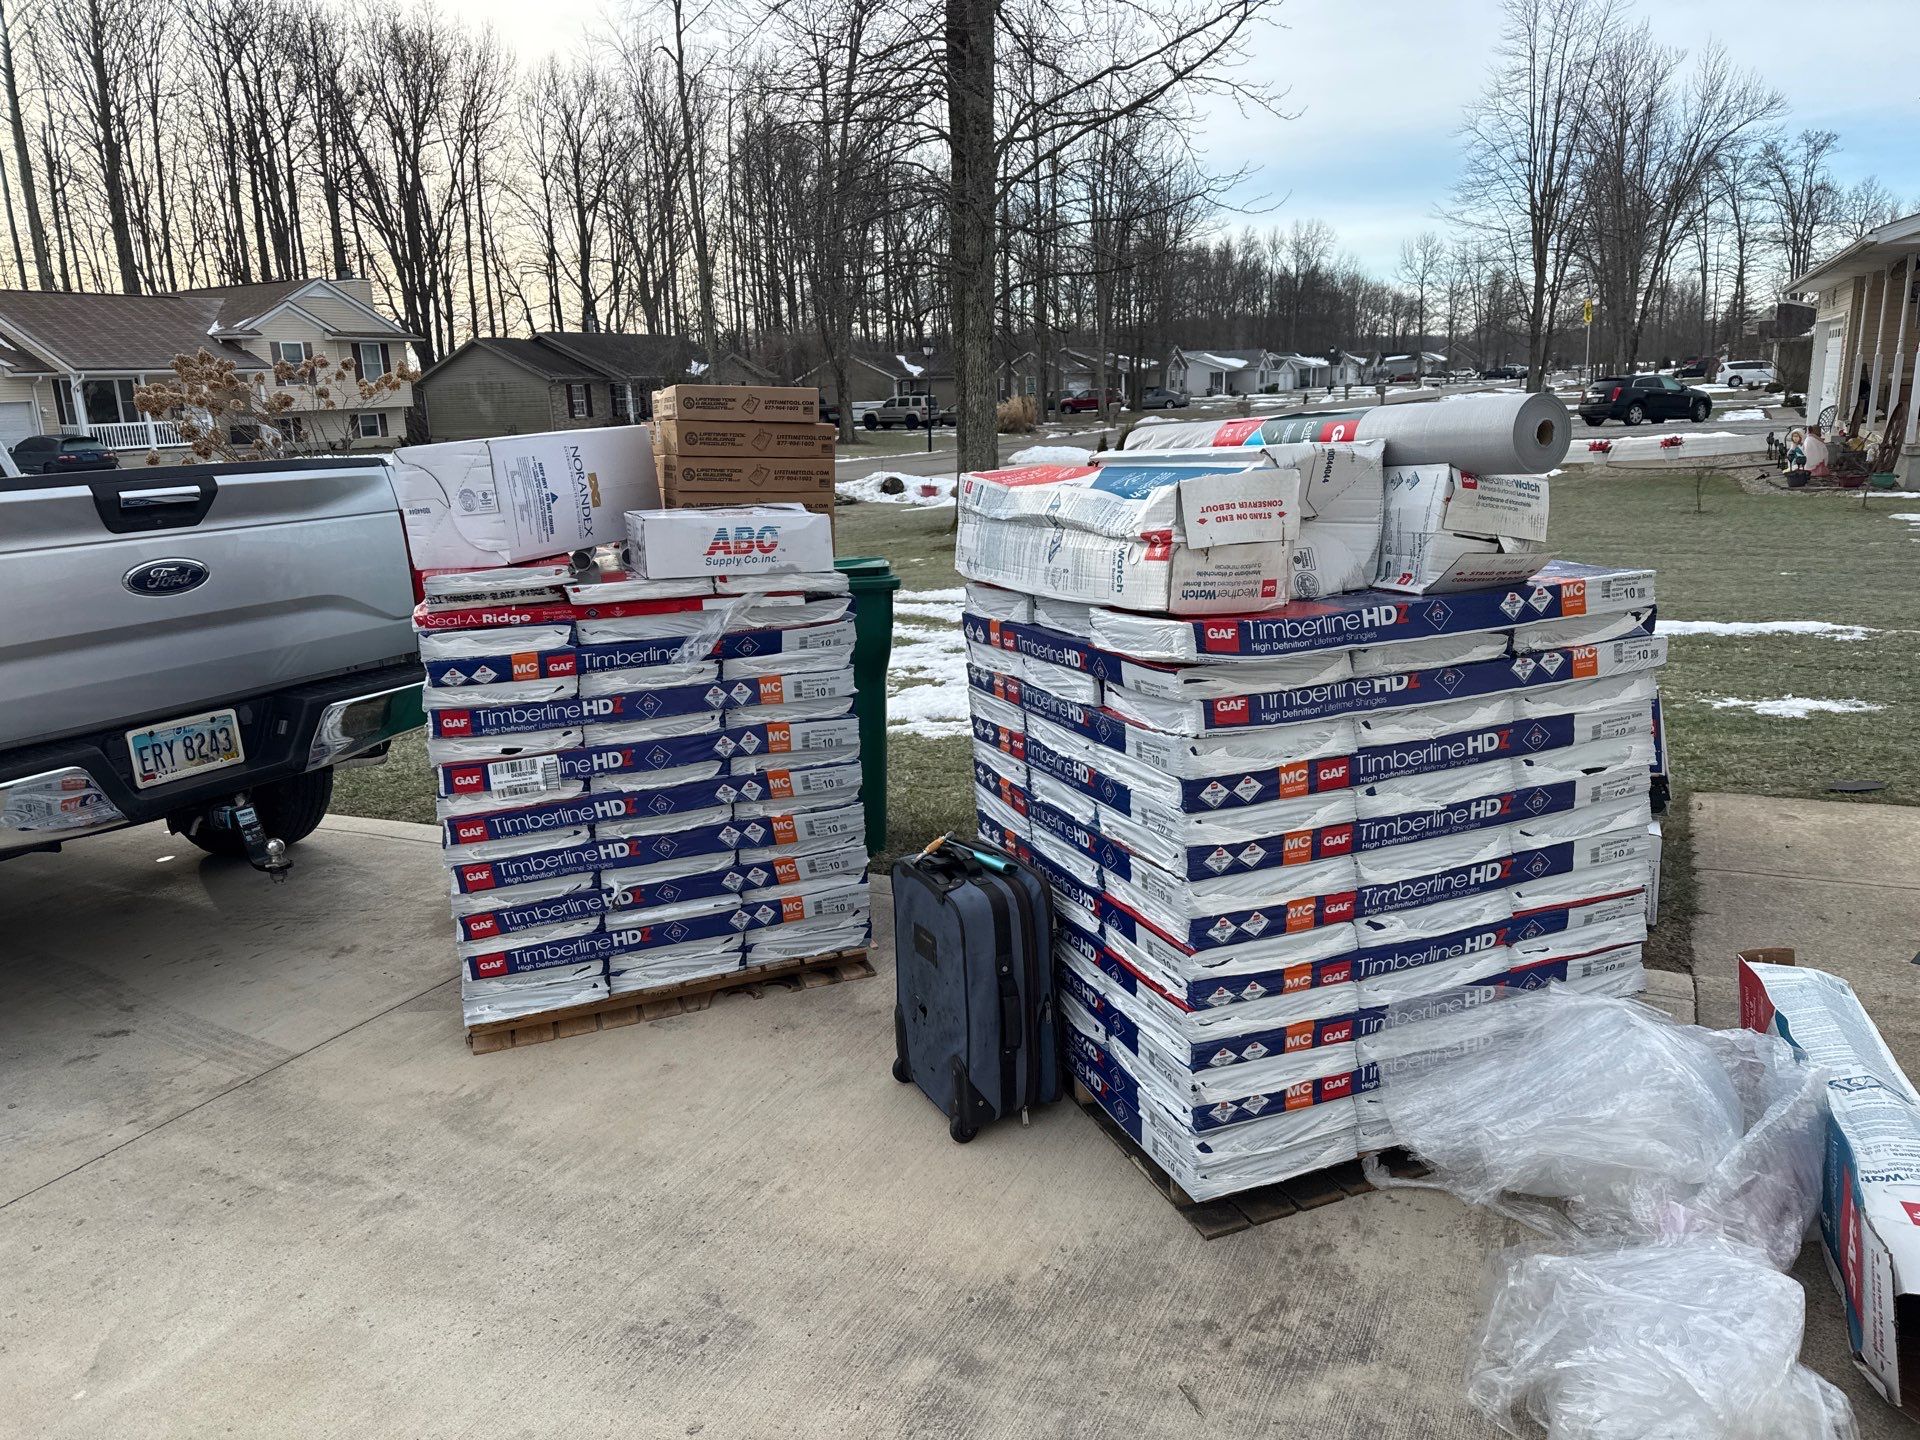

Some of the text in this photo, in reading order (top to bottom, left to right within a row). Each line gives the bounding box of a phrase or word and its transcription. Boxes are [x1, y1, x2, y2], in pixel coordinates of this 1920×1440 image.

[537, 462, 545, 477] KEEP
[570, 446, 593, 538] NORANDEX
[1200, 500, 1283, 514] CONSERVER DEBOUT
[1215, 511, 1272, 523] STAND ON END
[703, 525, 781, 556] ABC
[705, 556, 741, 567] Supply
[147, 566, 192, 589] Ford
[1181, 588, 1259, 601] WeatherWatch
[1561, 583, 1585, 598] MC
[1623, 587, 1636, 599] 10
[427, 612, 532, 627] Seal-A-Ridge
[989, 632, 1000, 641] MC
[1003, 637, 1015, 647] GAF
[1207, 627, 1236, 641] GAF
[820, 639, 831, 647] 10
[1251, 631, 1378, 653] High Definition Lifetime Shingles
[1573, 647, 1597, 660] MC
[1636, 650, 1649, 661] 10
[513, 662, 538, 675] MC
[549, 662, 574, 672] GAF
[760, 682, 782, 693] MC
[815, 688, 826, 697] 10
[1216, 699, 1246, 713] GAF
[1261, 696, 1388, 723] High Definition Lifetime Shingles
[442, 718, 468, 728] GAF
[501, 723, 535, 734] Definition
[769, 730, 790, 741] MC
[1614, 727, 1627, 737] 10
[822, 738, 833, 748] 10
[138, 726, 232, 774] ERY 8243
[1151, 754, 1160, 766] 10
[455, 775, 480, 786] GAF
[1281, 768, 1308, 785] MC
[1320, 766, 1347, 780] GAF
[1360, 768, 1416, 784] High Definition
[769, 777, 791, 789] MC
[823, 779, 834, 789] 10
[1614, 788, 1626, 797] 10
[773, 820, 794, 832] MC
[827, 824, 838, 834] 10
[460, 827, 484, 838] GAF
[1285, 835, 1312, 850] MC
[1323, 833, 1350, 847] GAF
[1362, 834, 1418, 850] High Definition
[1613, 849, 1625, 859] 10
[775, 863, 796, 875] MC
[828, 861, 840, 871] 10
[466, 870, 490, 881] GAF
[504, 875, 522, 885] High
[523, 870, 556, 882] Definition
[782, 901, 803, 913] MC
[834, 903, 846, 912] 10
[1287, 904, 1315, 919] MC
[1325, 901, 1351, 915] GAF
[1364, 906, 1383, 915] High
[1384, 899, 1419, 911] Definition
[470, 920, 494, 931] GAF
[509, 923, 526, 933] High
[480, 960, 505, 971] GAF
[517, 963, 535, 972] High
[536, 958, 569, 969] Definition
[1603, 963, 1615, 972] 10
[1284, 975, 1312, 989] MC
[1322, 970, 1349, 984] GAF
[1286, 1033, 1312, 1048] MC
[1324, 1029, 1349, 1042] GAF
[1286, 1077, 1349, 1097] MC GAF
